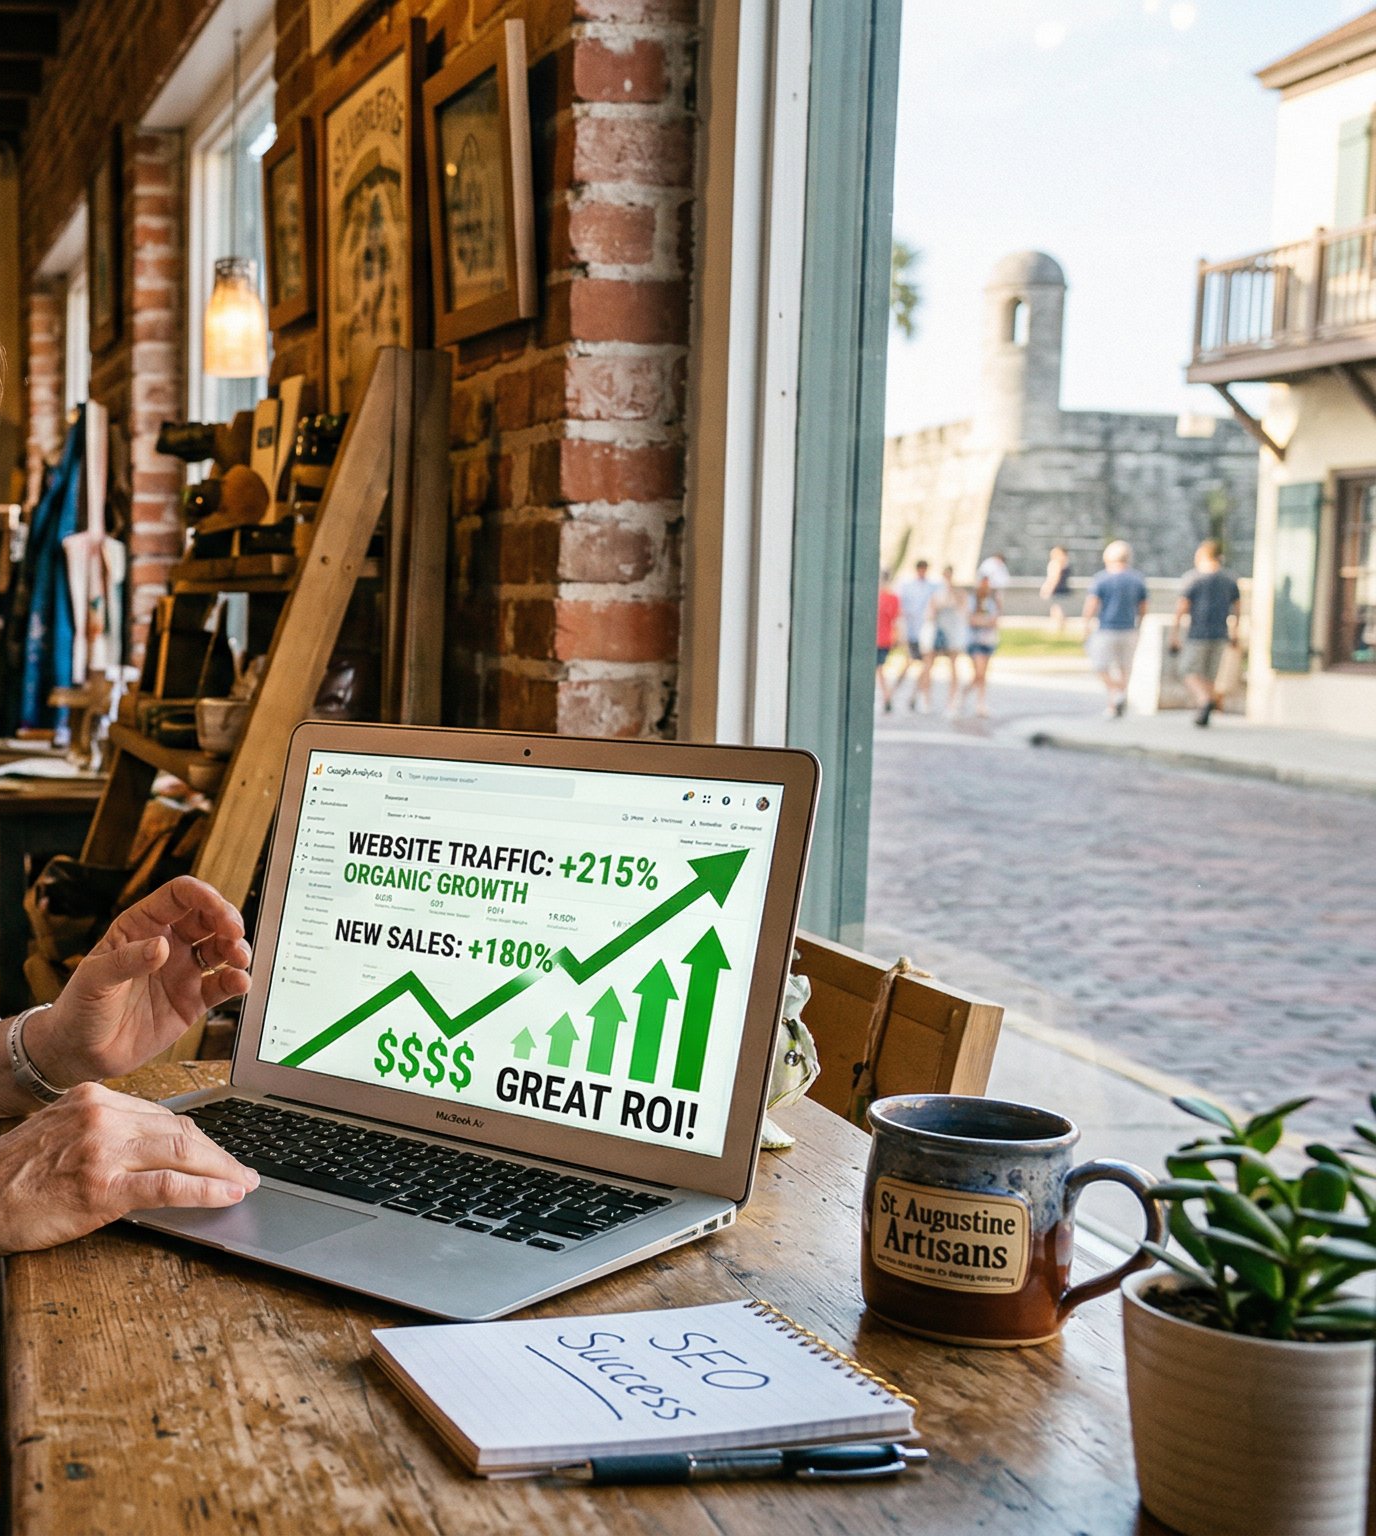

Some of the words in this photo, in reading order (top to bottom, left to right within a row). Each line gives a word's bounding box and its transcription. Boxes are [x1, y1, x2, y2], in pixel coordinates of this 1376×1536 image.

[344, 862, 432, 892] ORGANIC
[437, 873, 529, 904] GROWTH
[349, 831, 443, 863] WEBSITE
[448, 841, 554, 877] TRAFFIC:
[559, 852, 658, 891] +215%
[335, 918, 383, 946] NEW
[386, 926, 463, 958] SALES:
[468, 938, 553, 973] +180%
[374, 1027, 475, 1093] $$$$
[496, 1067, 612, 1121] GREAT
[620, 1090, 699, 1140] ROI!
[880, 1191, 900, 1218] St.
[904, 1198, 1016, 1235] Augustine
[883, 1217, 1008, 1269] Artisans
[557, 1332, 697, 1420] Success
[648, 1332, 771, 1390] SEO
